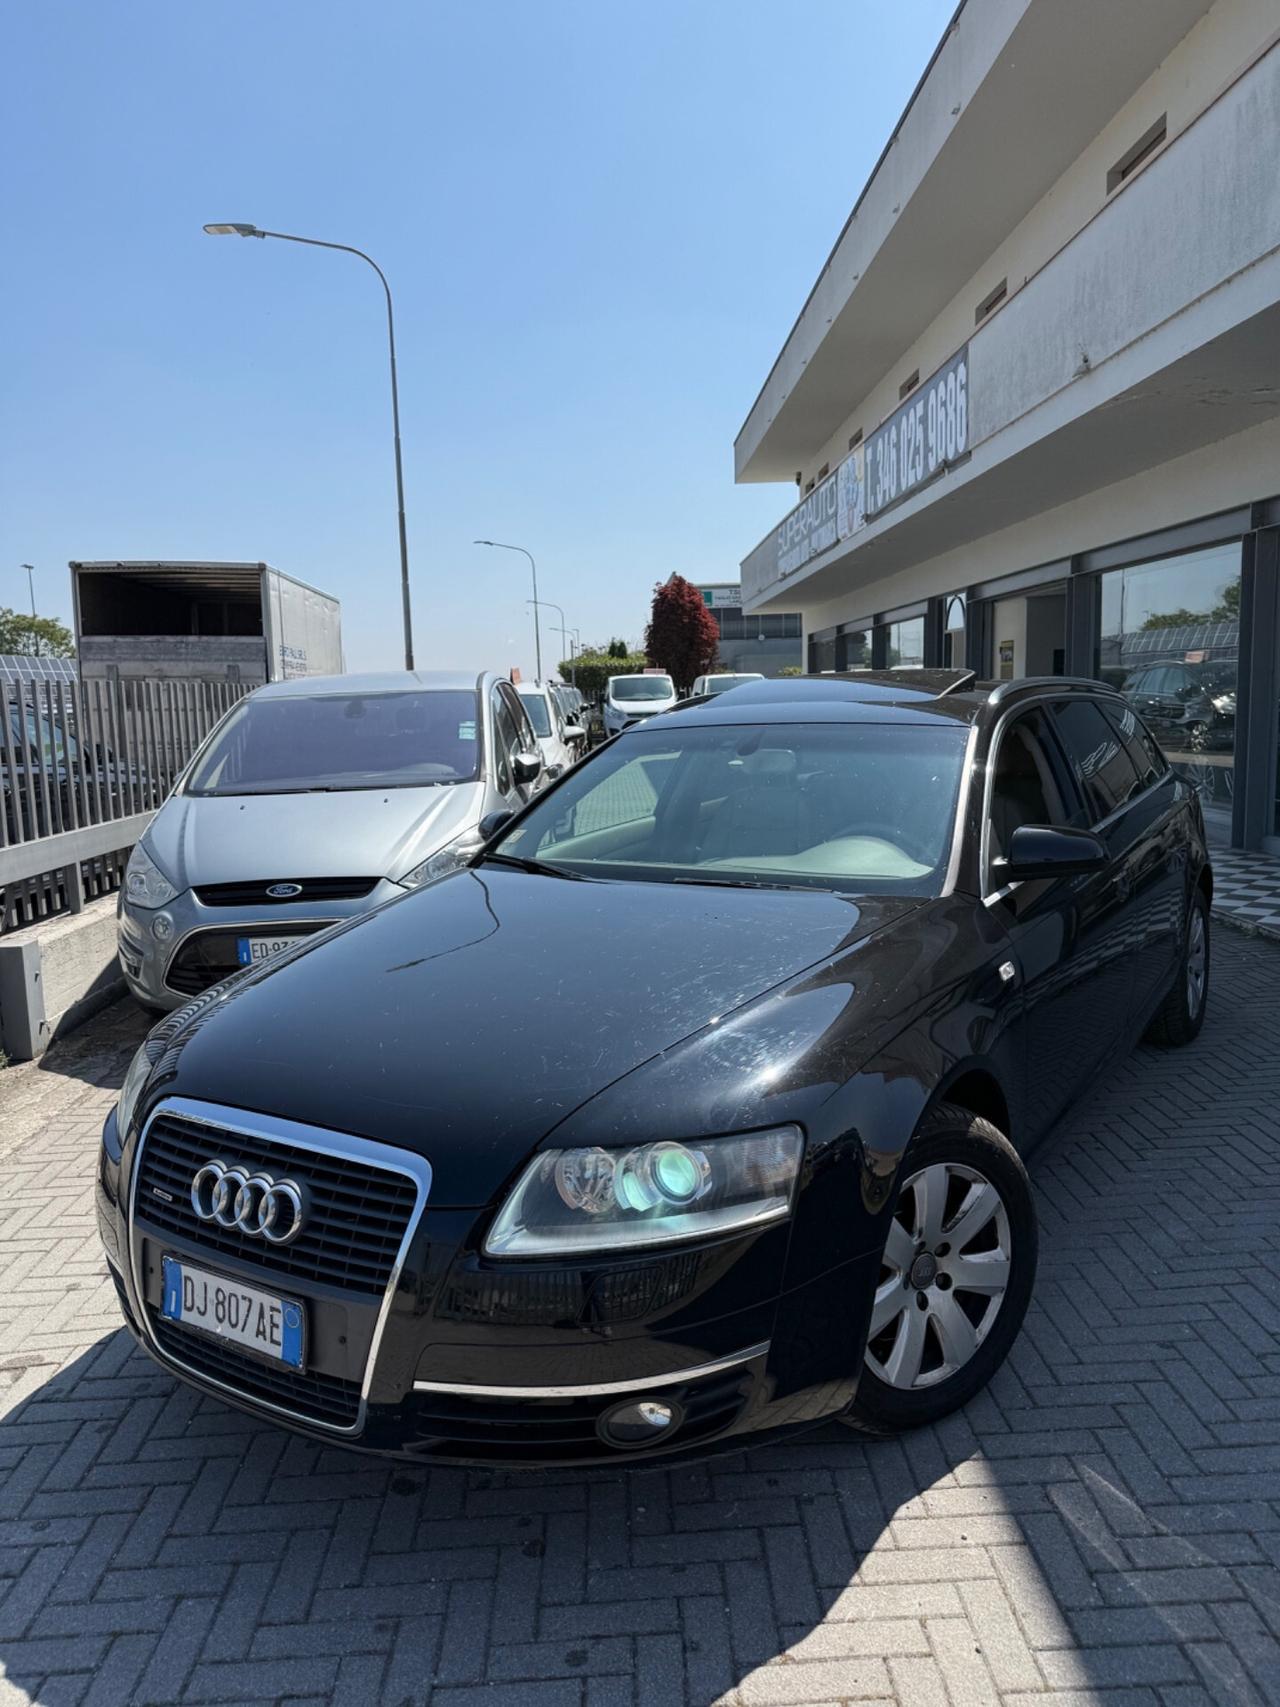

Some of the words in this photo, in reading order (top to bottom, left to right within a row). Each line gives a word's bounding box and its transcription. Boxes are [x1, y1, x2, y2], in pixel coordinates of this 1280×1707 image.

[866, 446, 874, 513] T.
[877, 425, 897, 508] 346
[900, 400, 924, 491] 025
[928, 362, 967, 472] 9686
